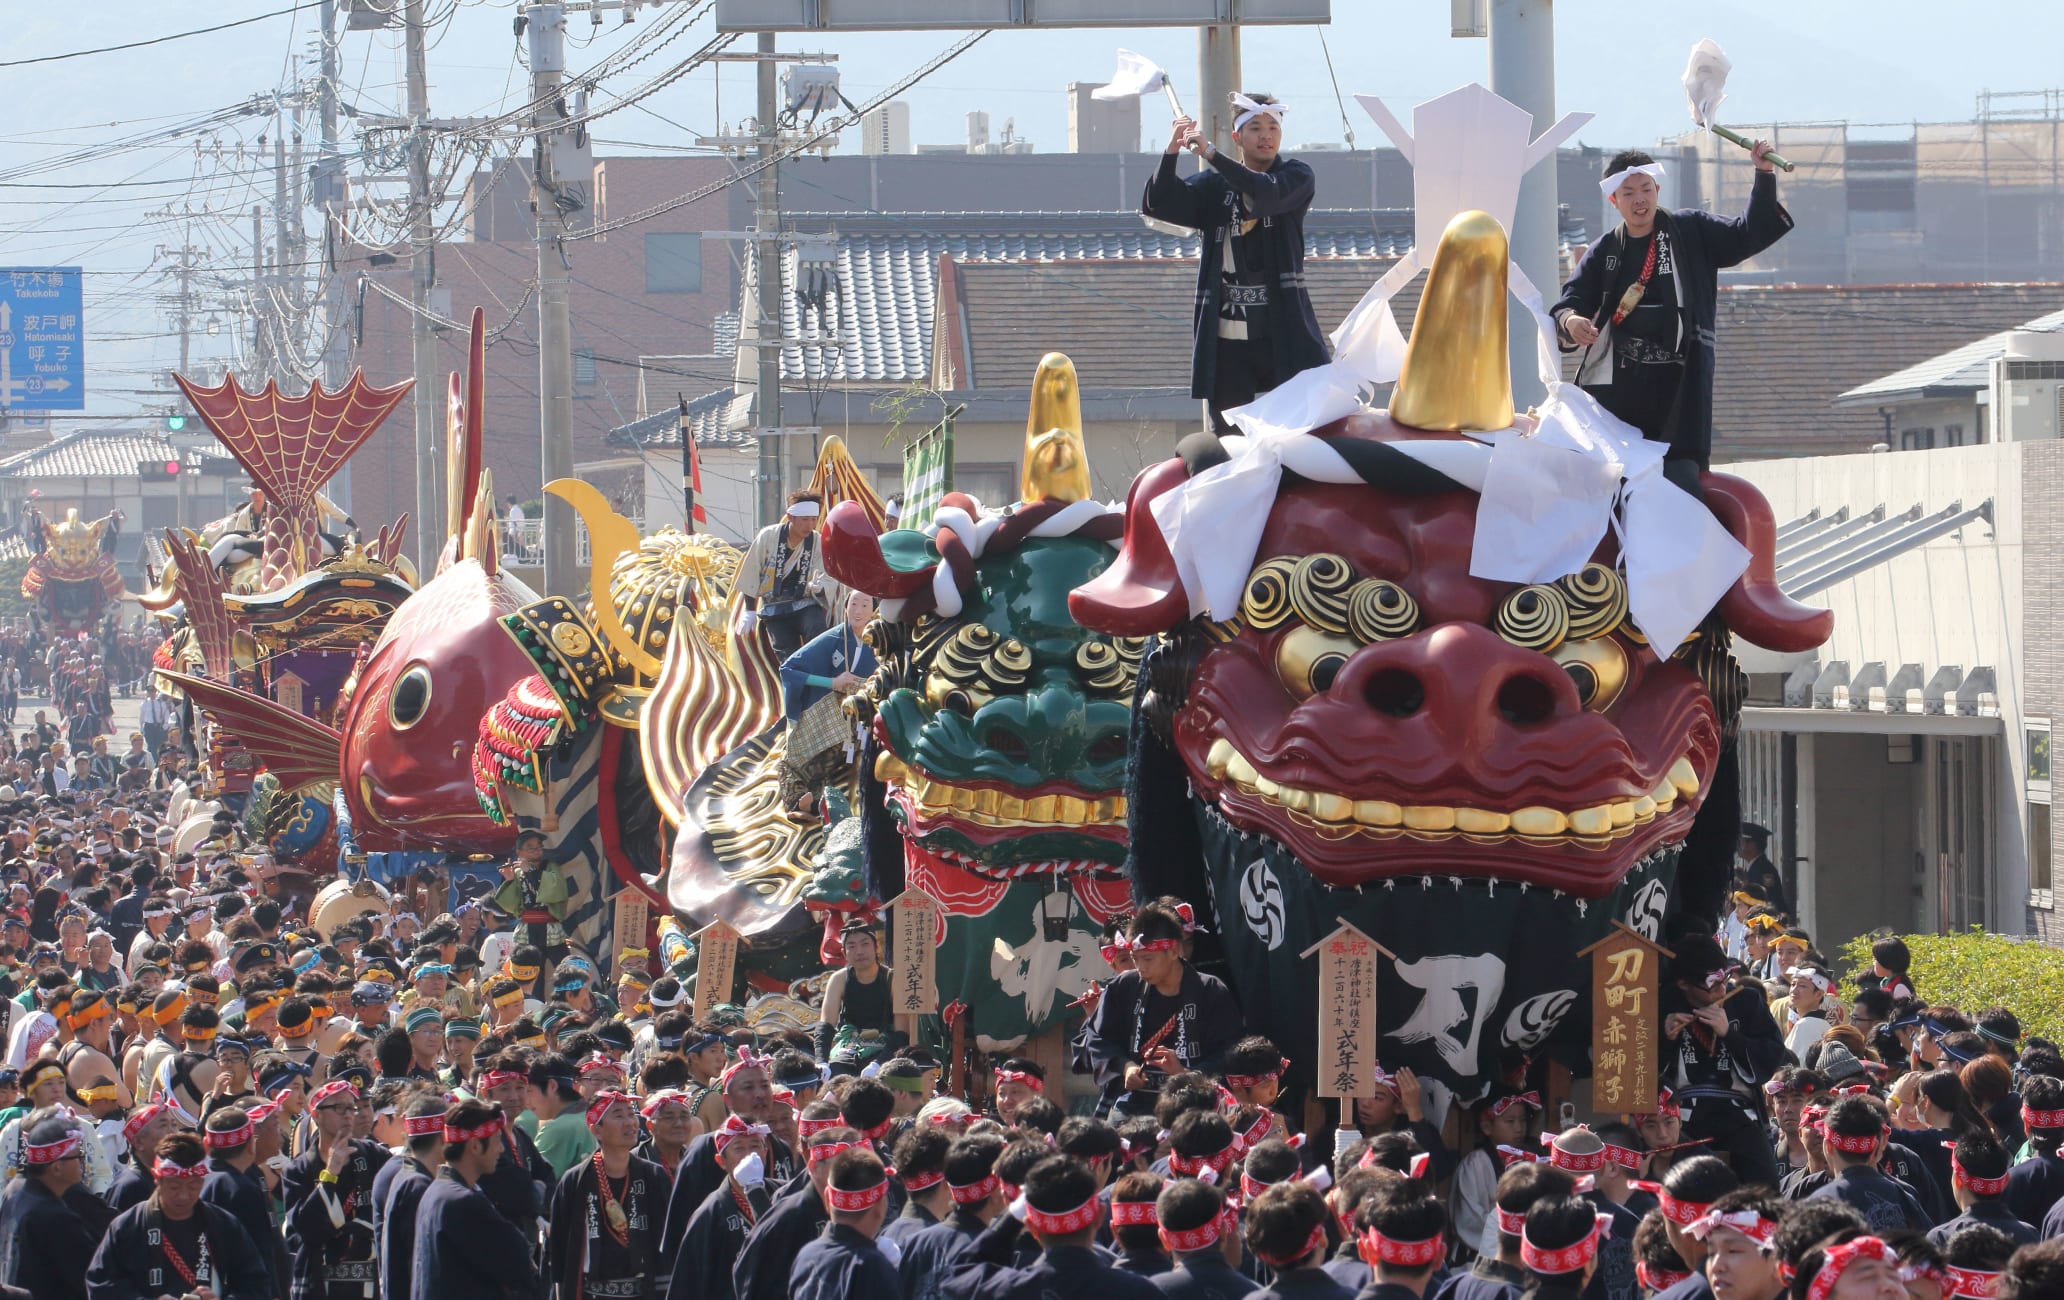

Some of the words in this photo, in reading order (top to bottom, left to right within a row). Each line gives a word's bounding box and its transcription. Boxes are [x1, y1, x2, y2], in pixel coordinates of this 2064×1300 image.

[16, 289, 60, 298] Takekoba
[24, 315, 76, 331] 波戸岬
[25, 333, 76, 342] Hatomisaki
[28, 345, 72, 361] 呼子
[34, 362, 68, 373] Yobuko
[29, 379, 41, 390] 23
[905, 964, 923, 1010] 式年祭
[1333, 957, 1346, 1028] 千二百六十年
[1383, 952, 1507, 1076] 刀
[1333, 1029, 1359, 1092] 式年祭
